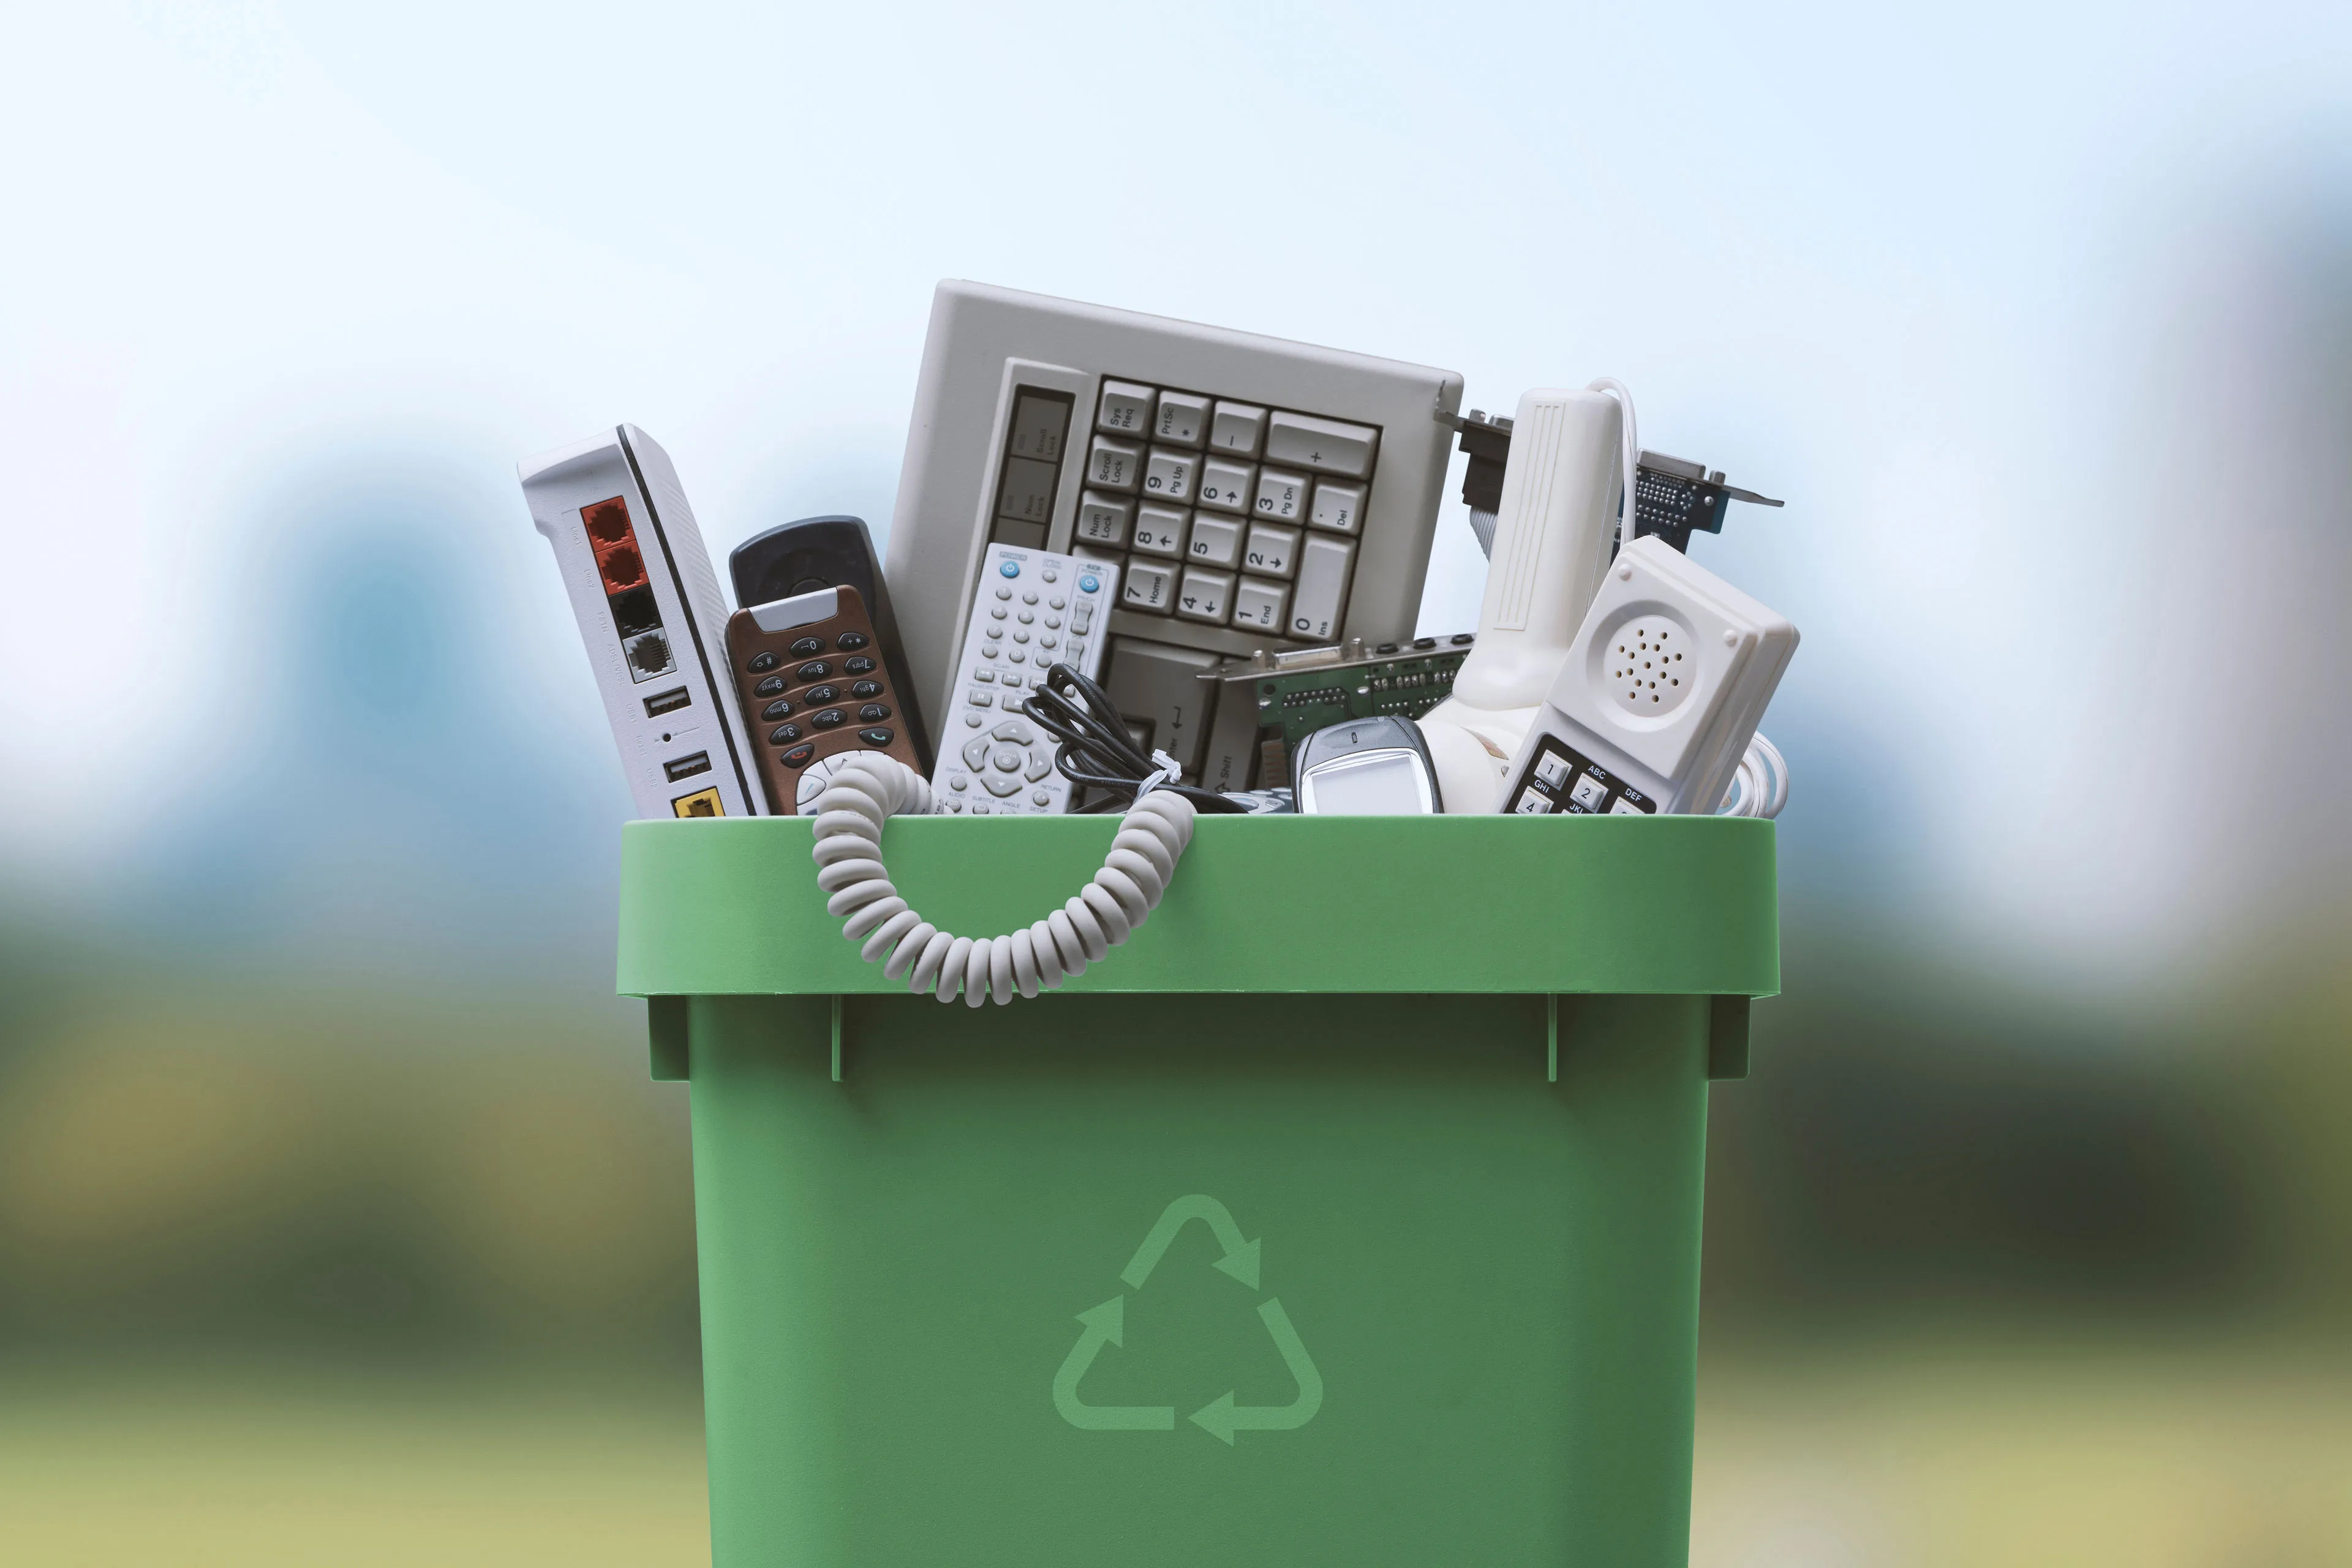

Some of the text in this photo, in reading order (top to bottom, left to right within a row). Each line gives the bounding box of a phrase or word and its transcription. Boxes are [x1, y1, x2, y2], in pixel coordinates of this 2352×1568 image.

[1110, 407, 1121, 426] Sys
[1123, 409, 1136, 428] Req
[1161, 407, 1174, 434] PrtSc
[1099, 453, 1112, 481] Scroll
[1112, 460, 1123, 483] Lock
[1147, 476, 1162, 489] 9
[1170, 466, 1184, 494] Pg Up
[1203, 486, 1218, 499] 6
[1259, 498, 1273, 511] 3
[1281, 488, 1293, 515] Pg Dn
[1337, 510, 1348, 526] Del
[1090, 514, 1101, 537] Num
[1101, 516, 1112, 538] Lock
[1137, 531, 1152, 545] 8
[1193, 542, 1208, 555] 5
[1248, 552, 1264, 565] 2
[1126, 587, 1140, 598] 7
[1149, 576, 1161, 604] Home
[1183, 597, 1197, 609] 4
[1261, 605, 1272, 625] End
[1295, 618, 1310, 631] 0
[1318, 621, 1328, 636] Ins
[809, 640, 817, 650] 0
[1221, 755, 1232, 779] Shift
[1547, 764, 1554, 775] 1
[1588, 765, 1607, 780] ABC
[647, 768, 658, 790] USB2
[1041, 784, 1062, 793] RETURN
[1534, 779, 1550, 794] GHI
[1581, 788, 1591, 799] 2
[973, 795, 996, 804] SUBTITLE
[1625, 788, 1643, 802] DEF
[1002, 800, 1021, 809] ANGLE
[1029, 805, 1048, 814] SETUP
[1526, 802, 1536, 813] 4
